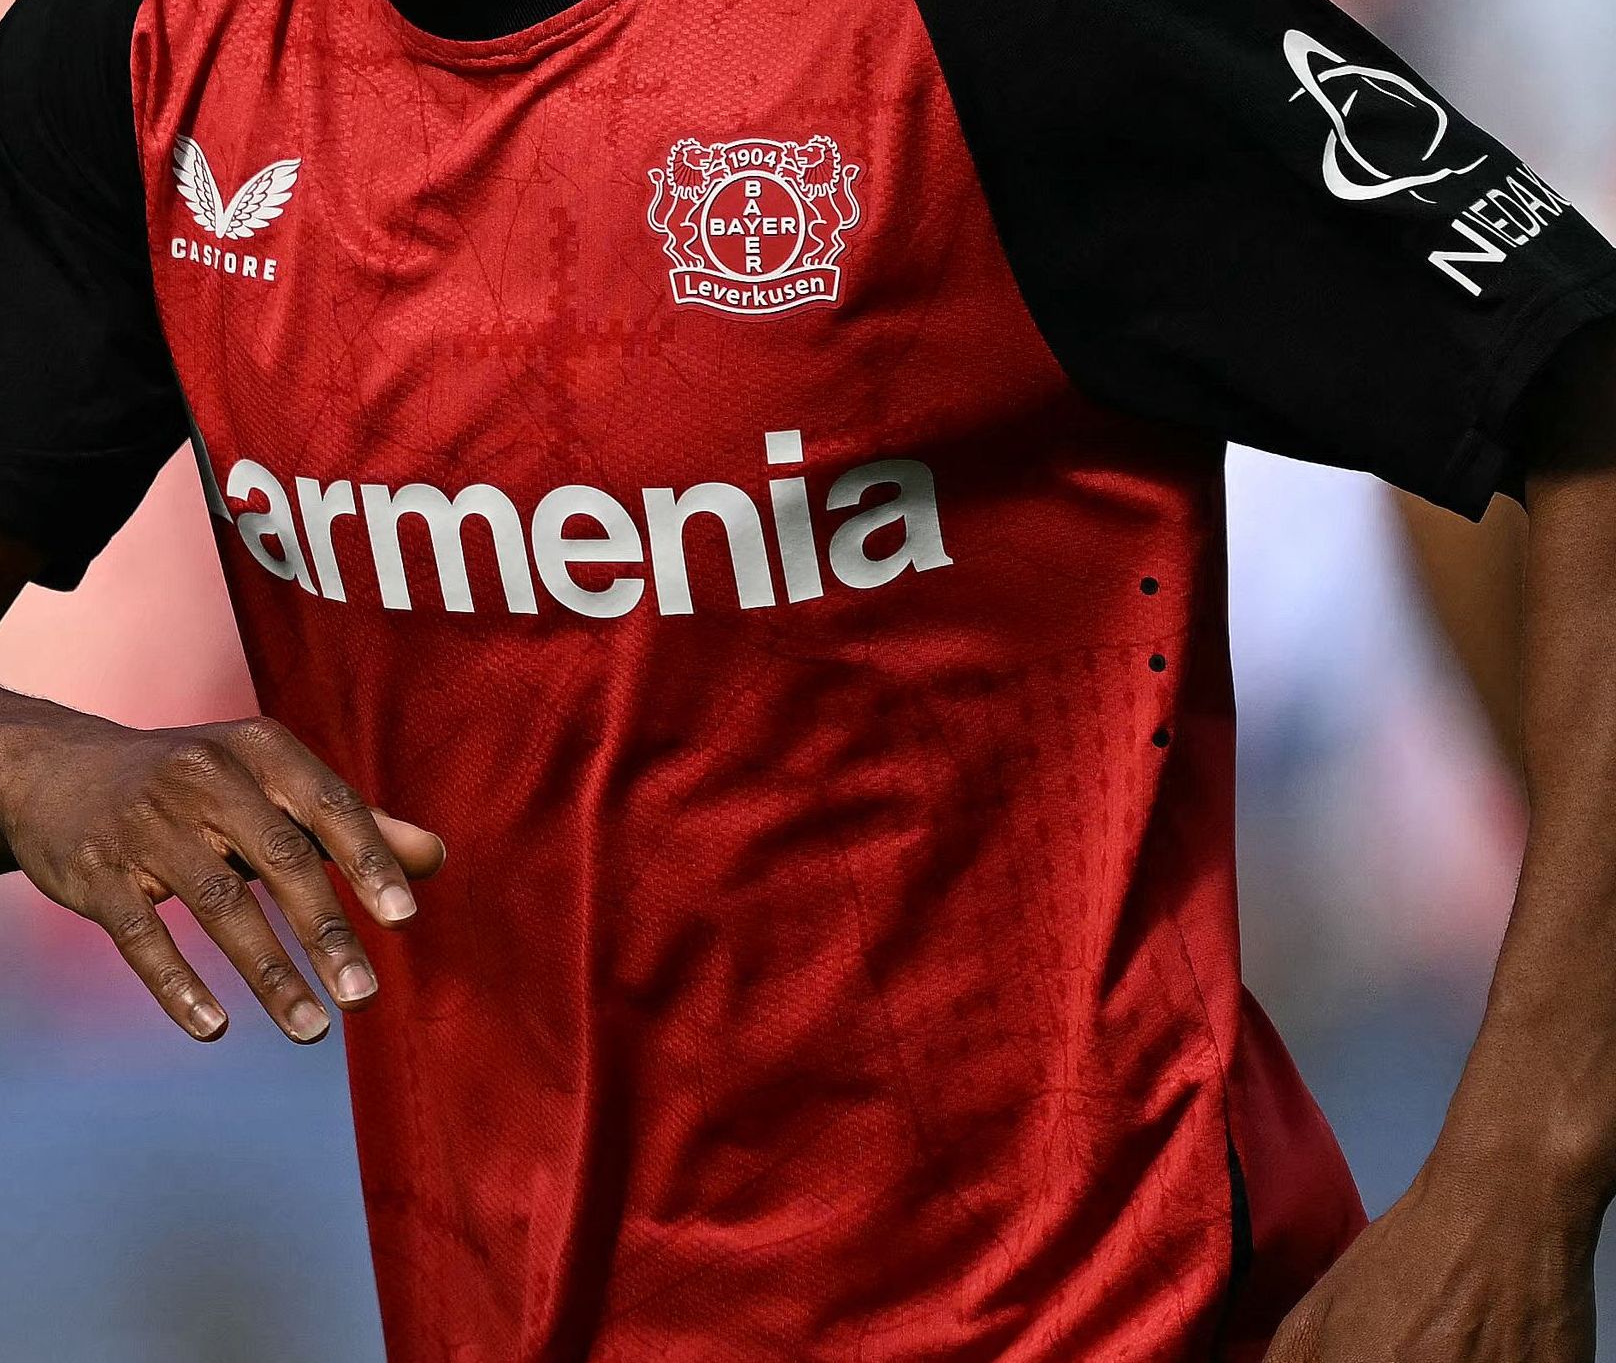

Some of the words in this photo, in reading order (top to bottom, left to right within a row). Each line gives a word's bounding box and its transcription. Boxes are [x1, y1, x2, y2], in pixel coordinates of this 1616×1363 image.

[728, 148, 777, 168] 1904
[709, 217, 797, 236] BAYER
[742, 180, 763, 273] BAYER
[1427, 162, 1572, 297] NIEDAX
[171, 237, 277, 281] CASTORE
[684, 275, 825, 306] Leverkusen
[188, 418, 954, 619] armenia
